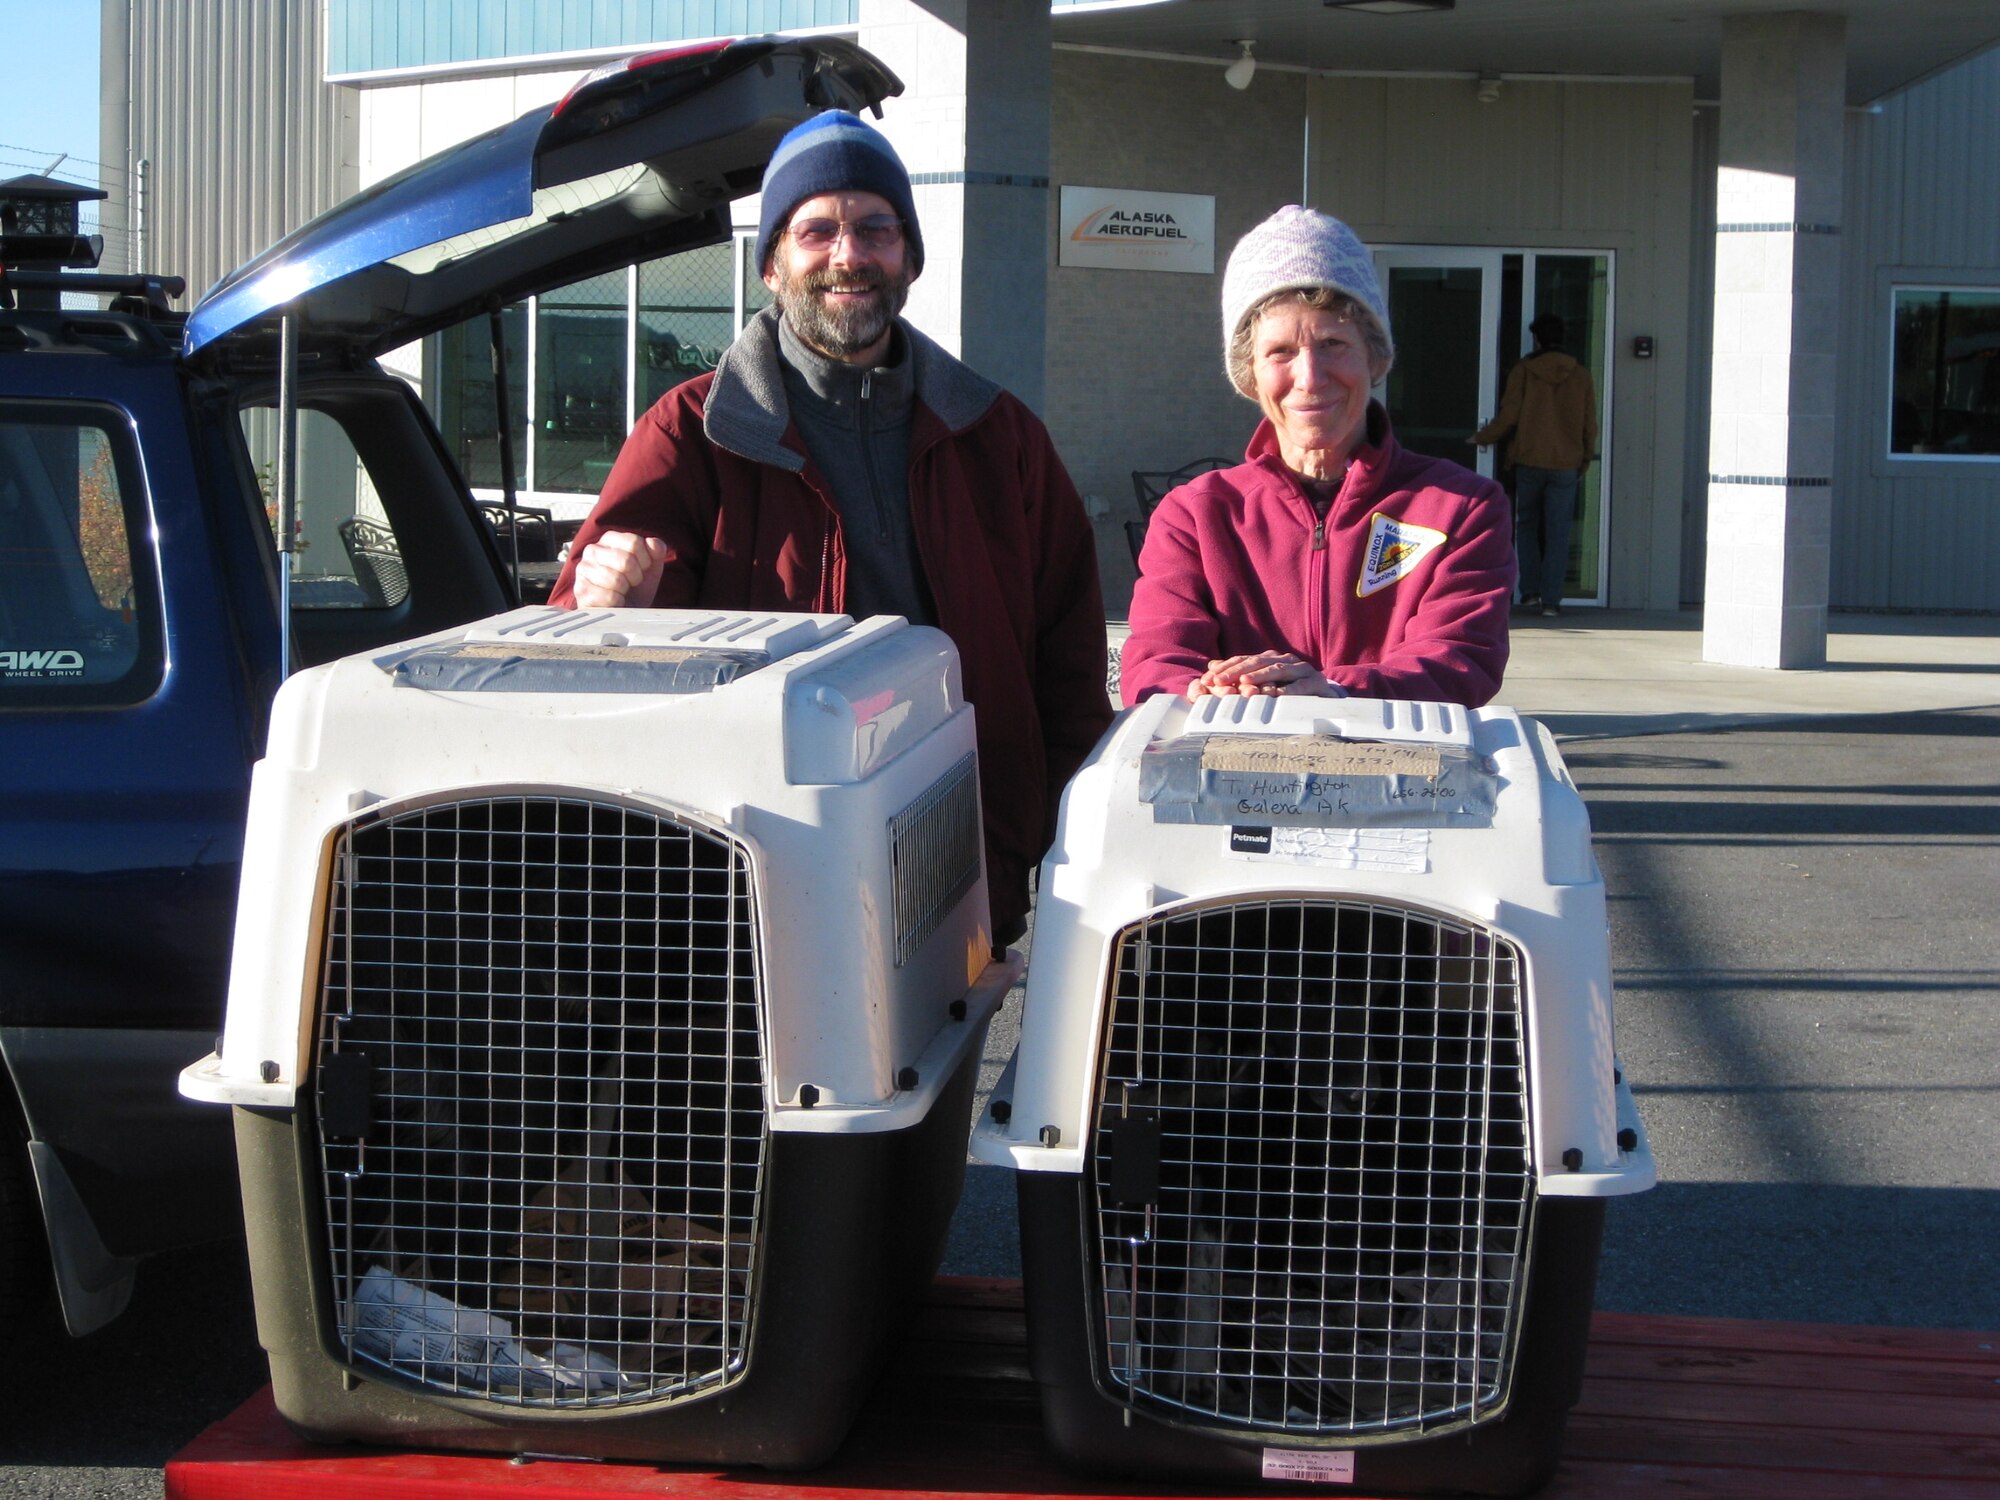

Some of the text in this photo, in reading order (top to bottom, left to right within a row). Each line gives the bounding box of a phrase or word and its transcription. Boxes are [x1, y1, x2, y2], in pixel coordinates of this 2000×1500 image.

[1109, 210, 1176, 224] ALASKA
[1097, 224, 1187, 239] AEROFUEL
[1367, 533, 1384, 572] EQUINOX
[1367, 569, 1398, 586] Running
[1237, 798, 1303, 815] Galena
[1233, 833, 1269, 844] Petmate
